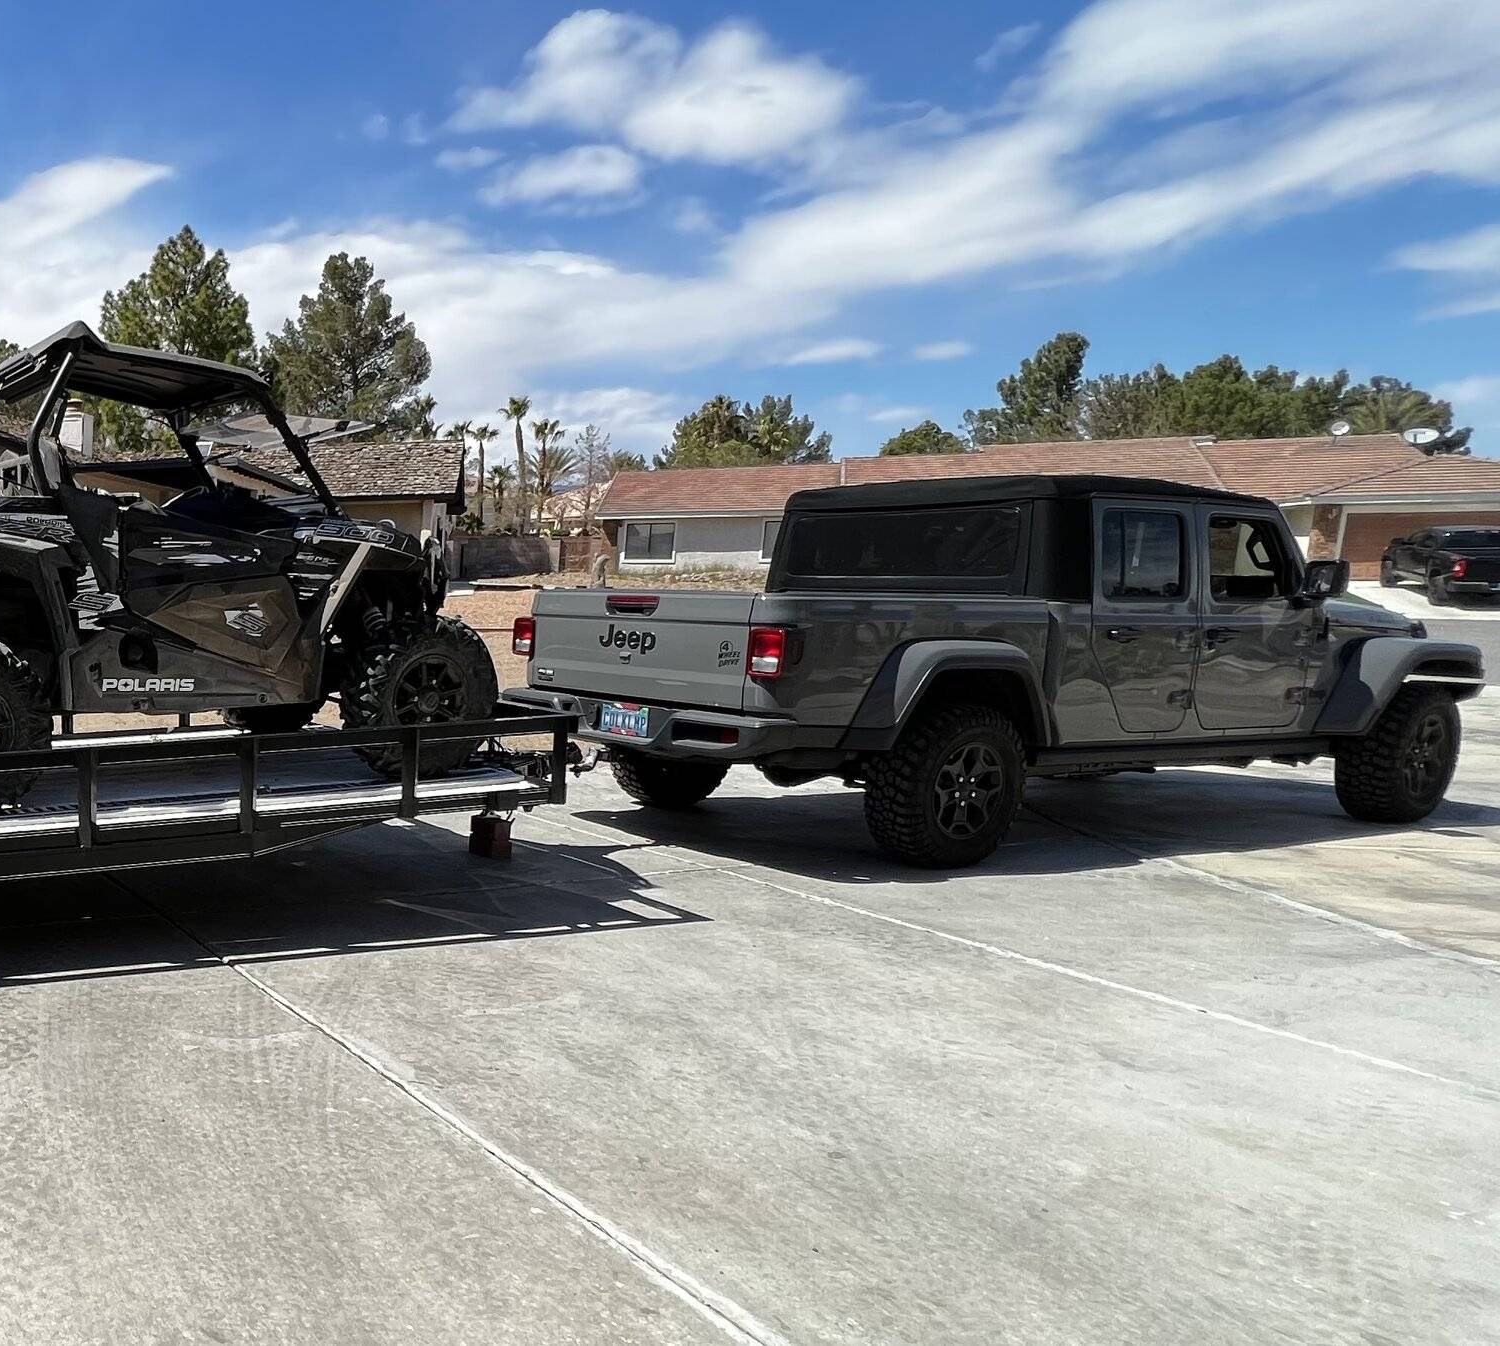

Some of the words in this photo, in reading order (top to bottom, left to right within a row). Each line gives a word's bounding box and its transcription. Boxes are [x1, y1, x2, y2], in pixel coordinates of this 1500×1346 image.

[315, 523, 395, 544] 900
[599, 623, 656, 655] Jeep
[102, 678, 195, 692] POLARIS
